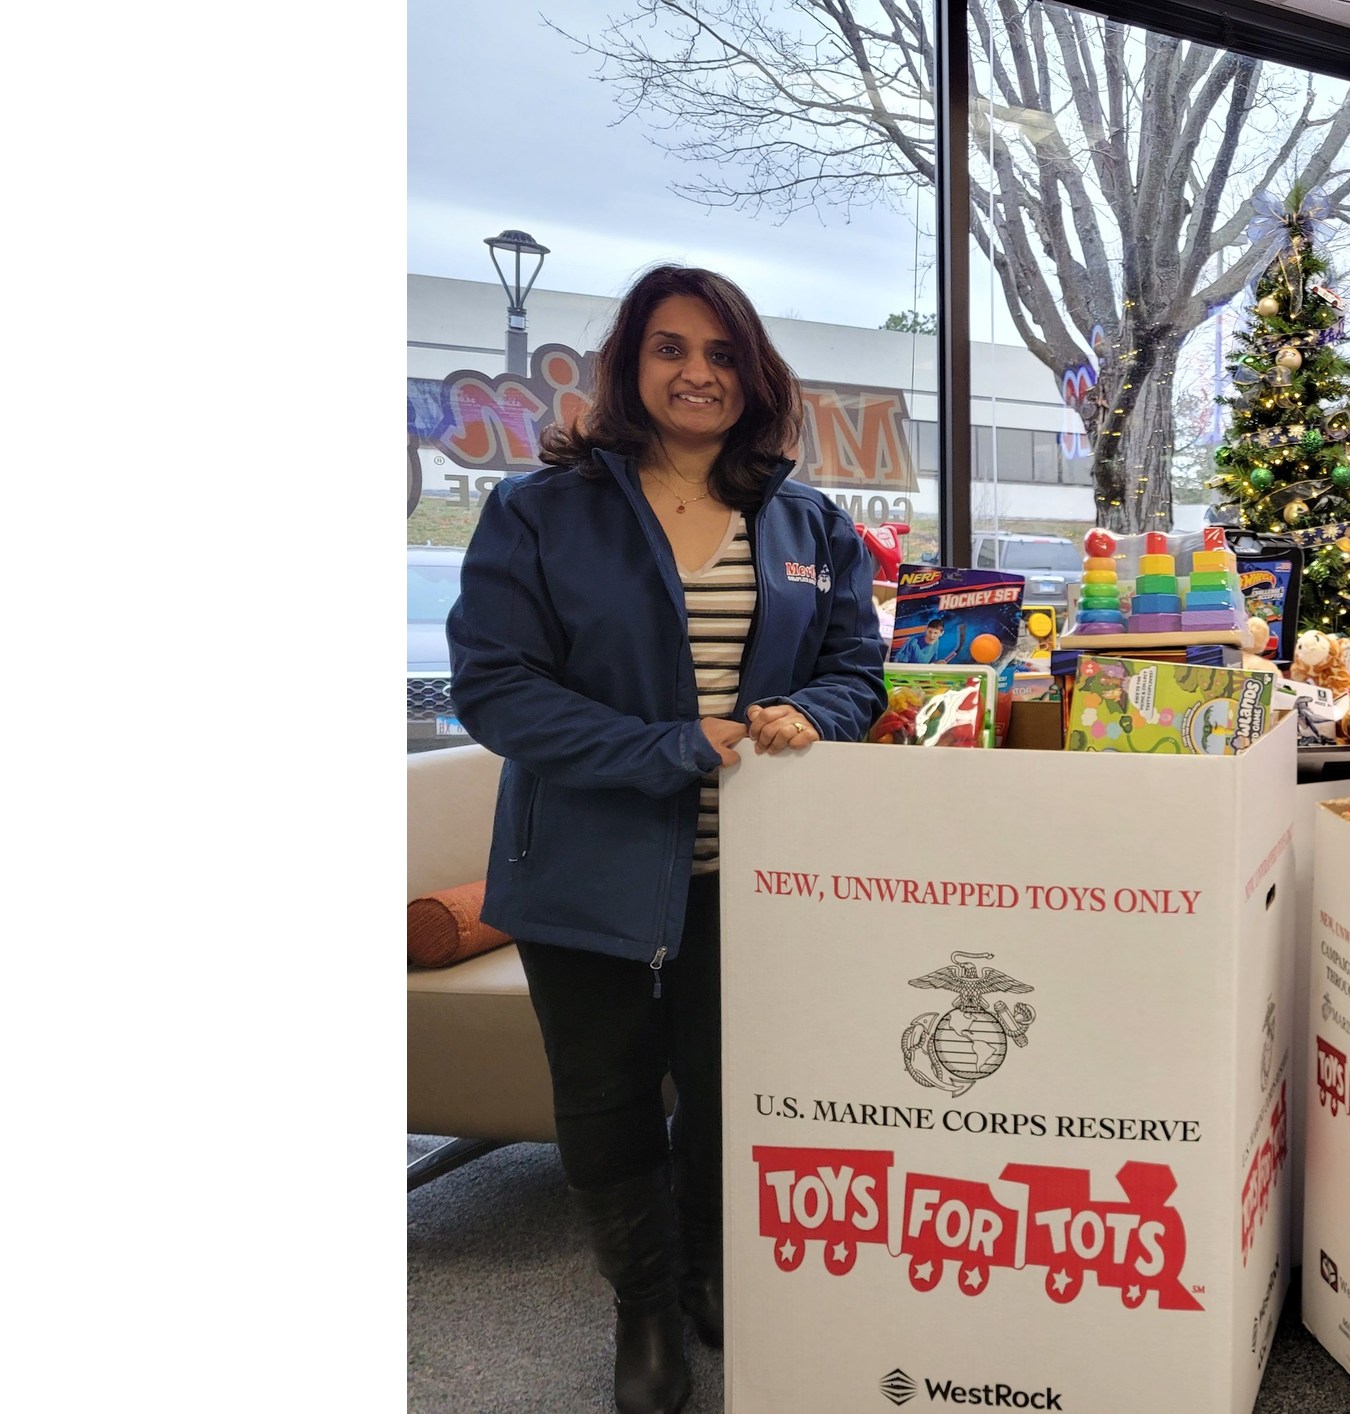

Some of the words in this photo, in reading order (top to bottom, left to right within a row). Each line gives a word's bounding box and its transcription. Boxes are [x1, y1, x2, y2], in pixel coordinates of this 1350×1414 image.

[900, 571, 941, 586] NERF
[939, 590, 992, 611] HOCKEY
[994, 587, 1021, 603] SET
[753, 869, 824, 903] NEW,
[831, 875, 1019, 910] UNWRAPPED
[1025, 884, 1107, 913] TOYS
[1113, 887, 1203, 916] ONLY
[1318, 1051, 1345, 1098] TOYS
[753, 1093, 805, 1120] U.S.
[813, 1099, 936, 1130] MARINE
[941, 1108, 1048, 1137] CORPS
[1055, 1115, 1202, 1143] RESERVE
[765, 1164, 881, 1232] TOYS
[907, 1188, 1004, 1257] FOR
[1035, 1208, 1167, 1278] TOTS
[924, 1377, 1064, 1412] WestRock
